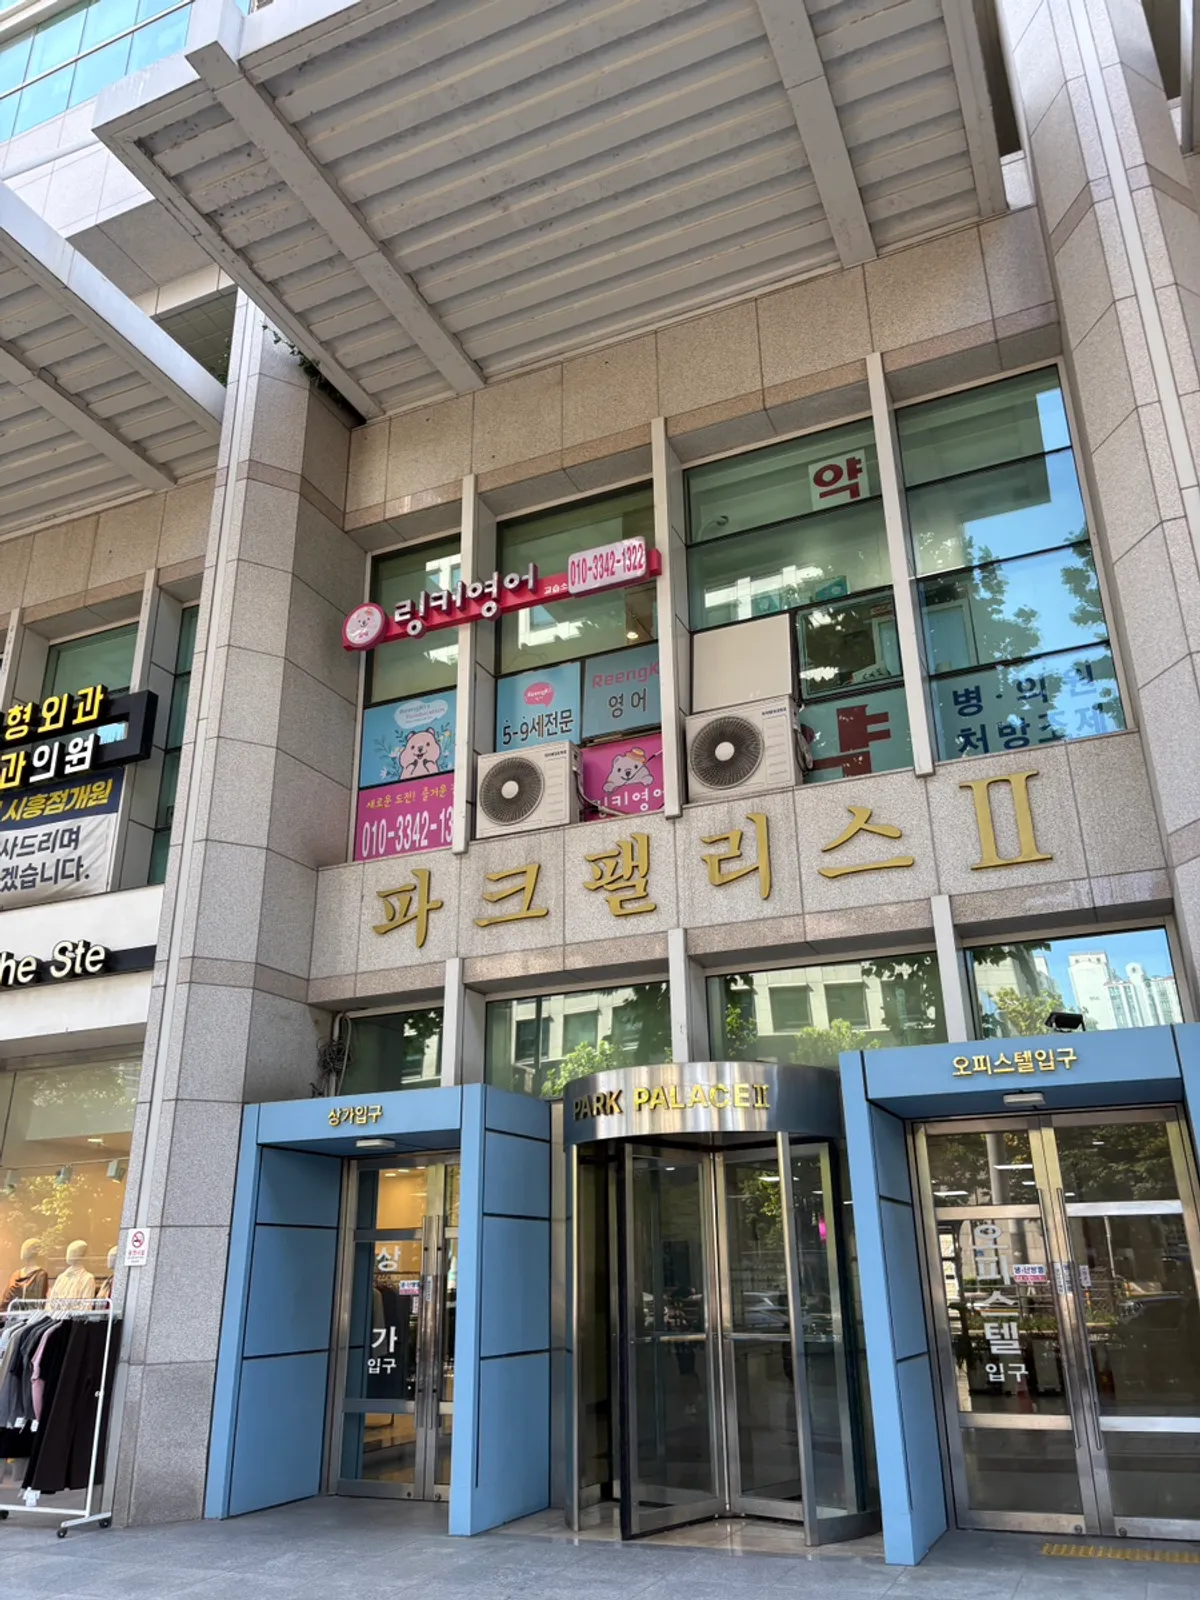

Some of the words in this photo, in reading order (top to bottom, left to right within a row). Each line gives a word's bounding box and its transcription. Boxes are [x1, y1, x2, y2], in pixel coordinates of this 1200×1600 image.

[813, 456, 863, 499] 약
[570, 543, 644, 587] 010-3342-1322
[394, 562, 534, 636] 링키영어
[372, 806, 915, 949] 파크팰리스
[50, 940, 106, 978] Ste
[952, 1047, 1078, 1077] 오피스텔입구
[327, 1105, 383, 1126] 상가입구
[573, 1089, 623, 1121] PARK
[367, 1357, 397, 1375] 입구
[985, 1362, 1029, 1383] 입구
